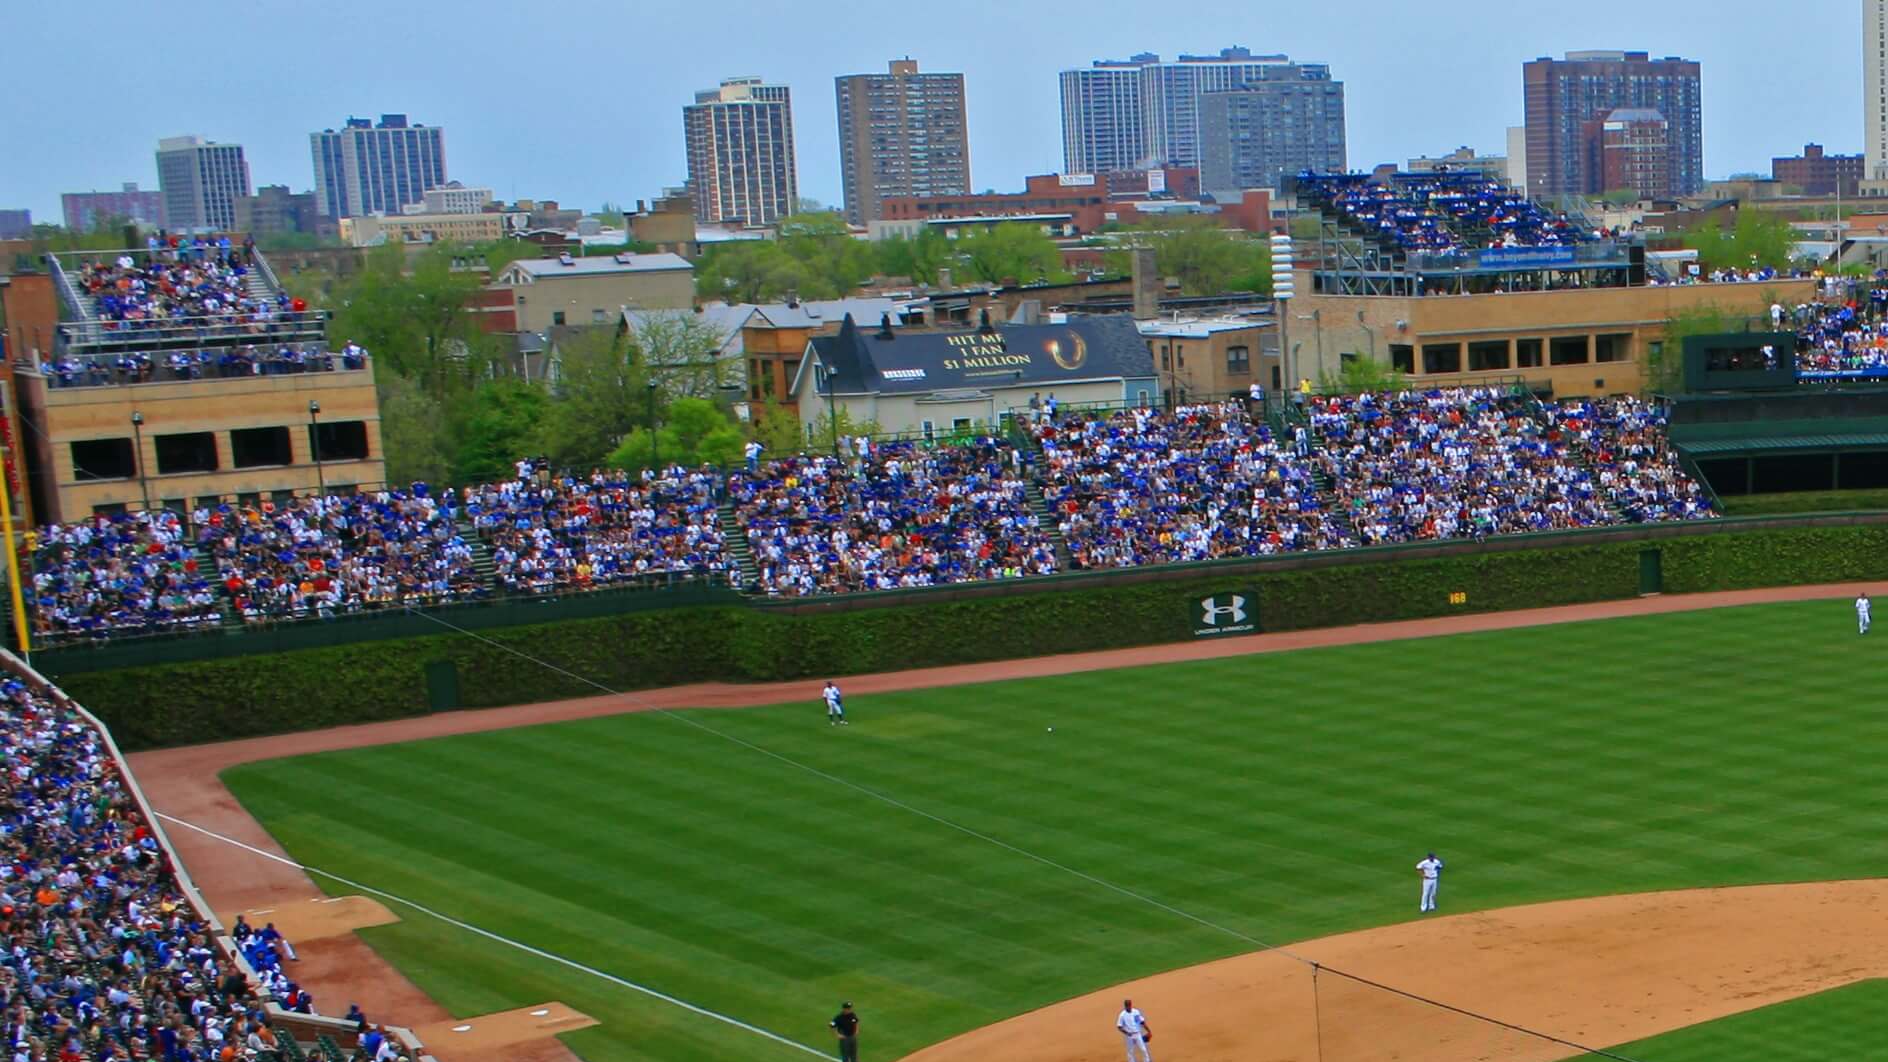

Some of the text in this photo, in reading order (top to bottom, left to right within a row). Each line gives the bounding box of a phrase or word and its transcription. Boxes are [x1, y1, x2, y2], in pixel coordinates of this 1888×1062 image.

[947, 335, 976, 346] HIT
[972, 345, 1004, 356] FAN
[964, 355, 1031, 368] MILLION
